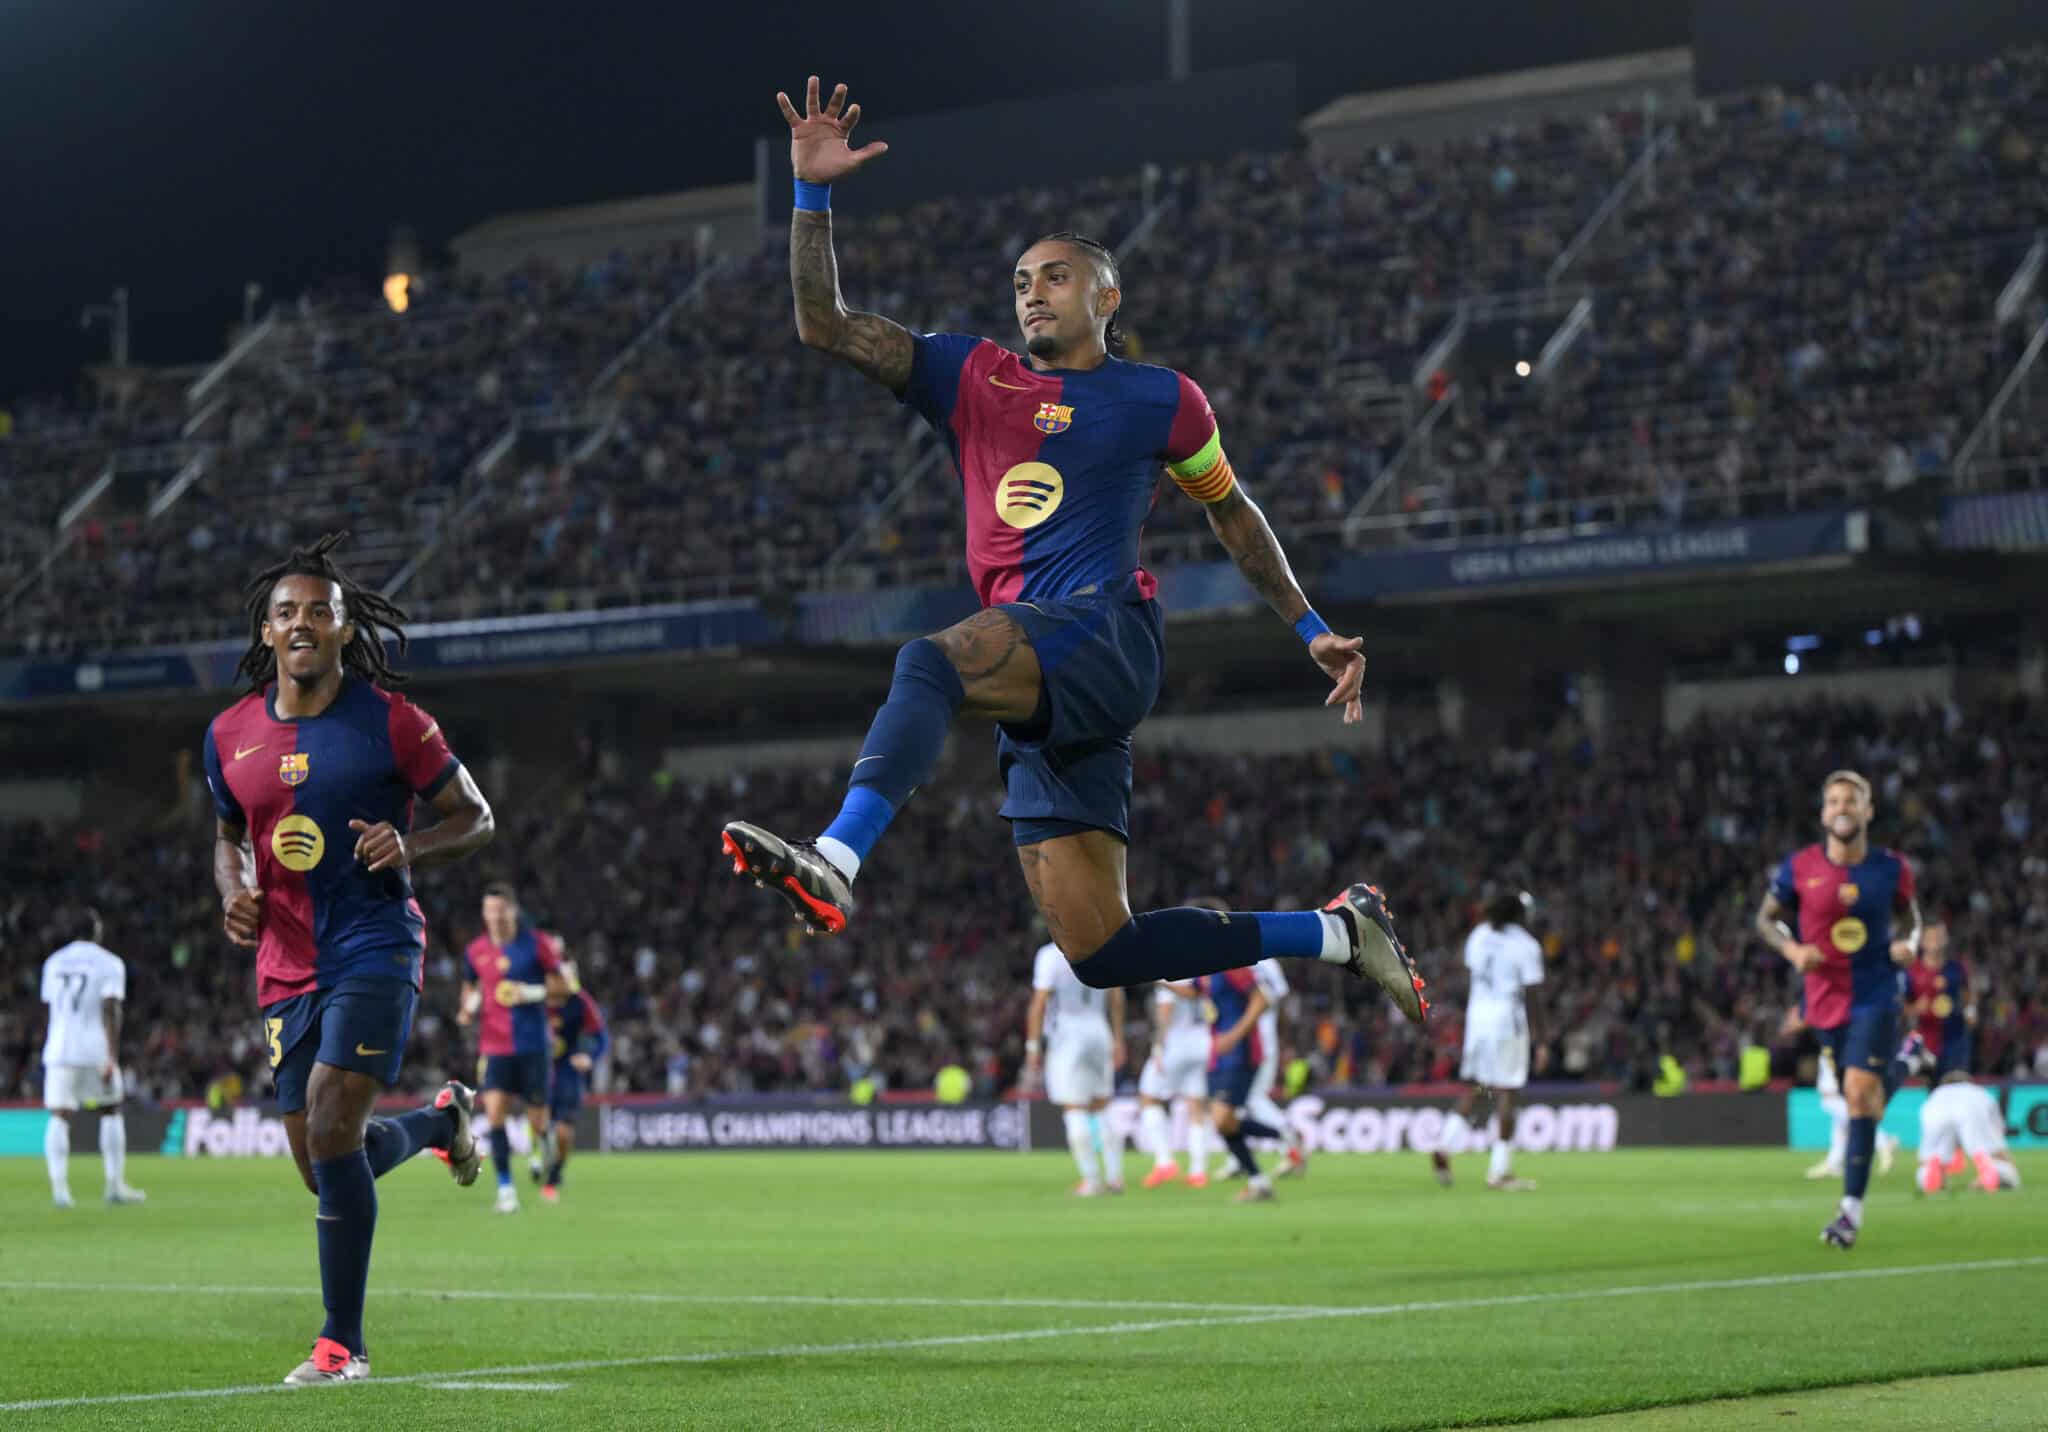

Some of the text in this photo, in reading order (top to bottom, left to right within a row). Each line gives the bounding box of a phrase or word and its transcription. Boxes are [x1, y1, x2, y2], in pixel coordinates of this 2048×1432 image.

[56, 971, 88, 1013] 77
[265, 1017, 283, 1068] 3
[639, 1110, 984, 1146] UEFA CHAMPIONS LEAGUE
